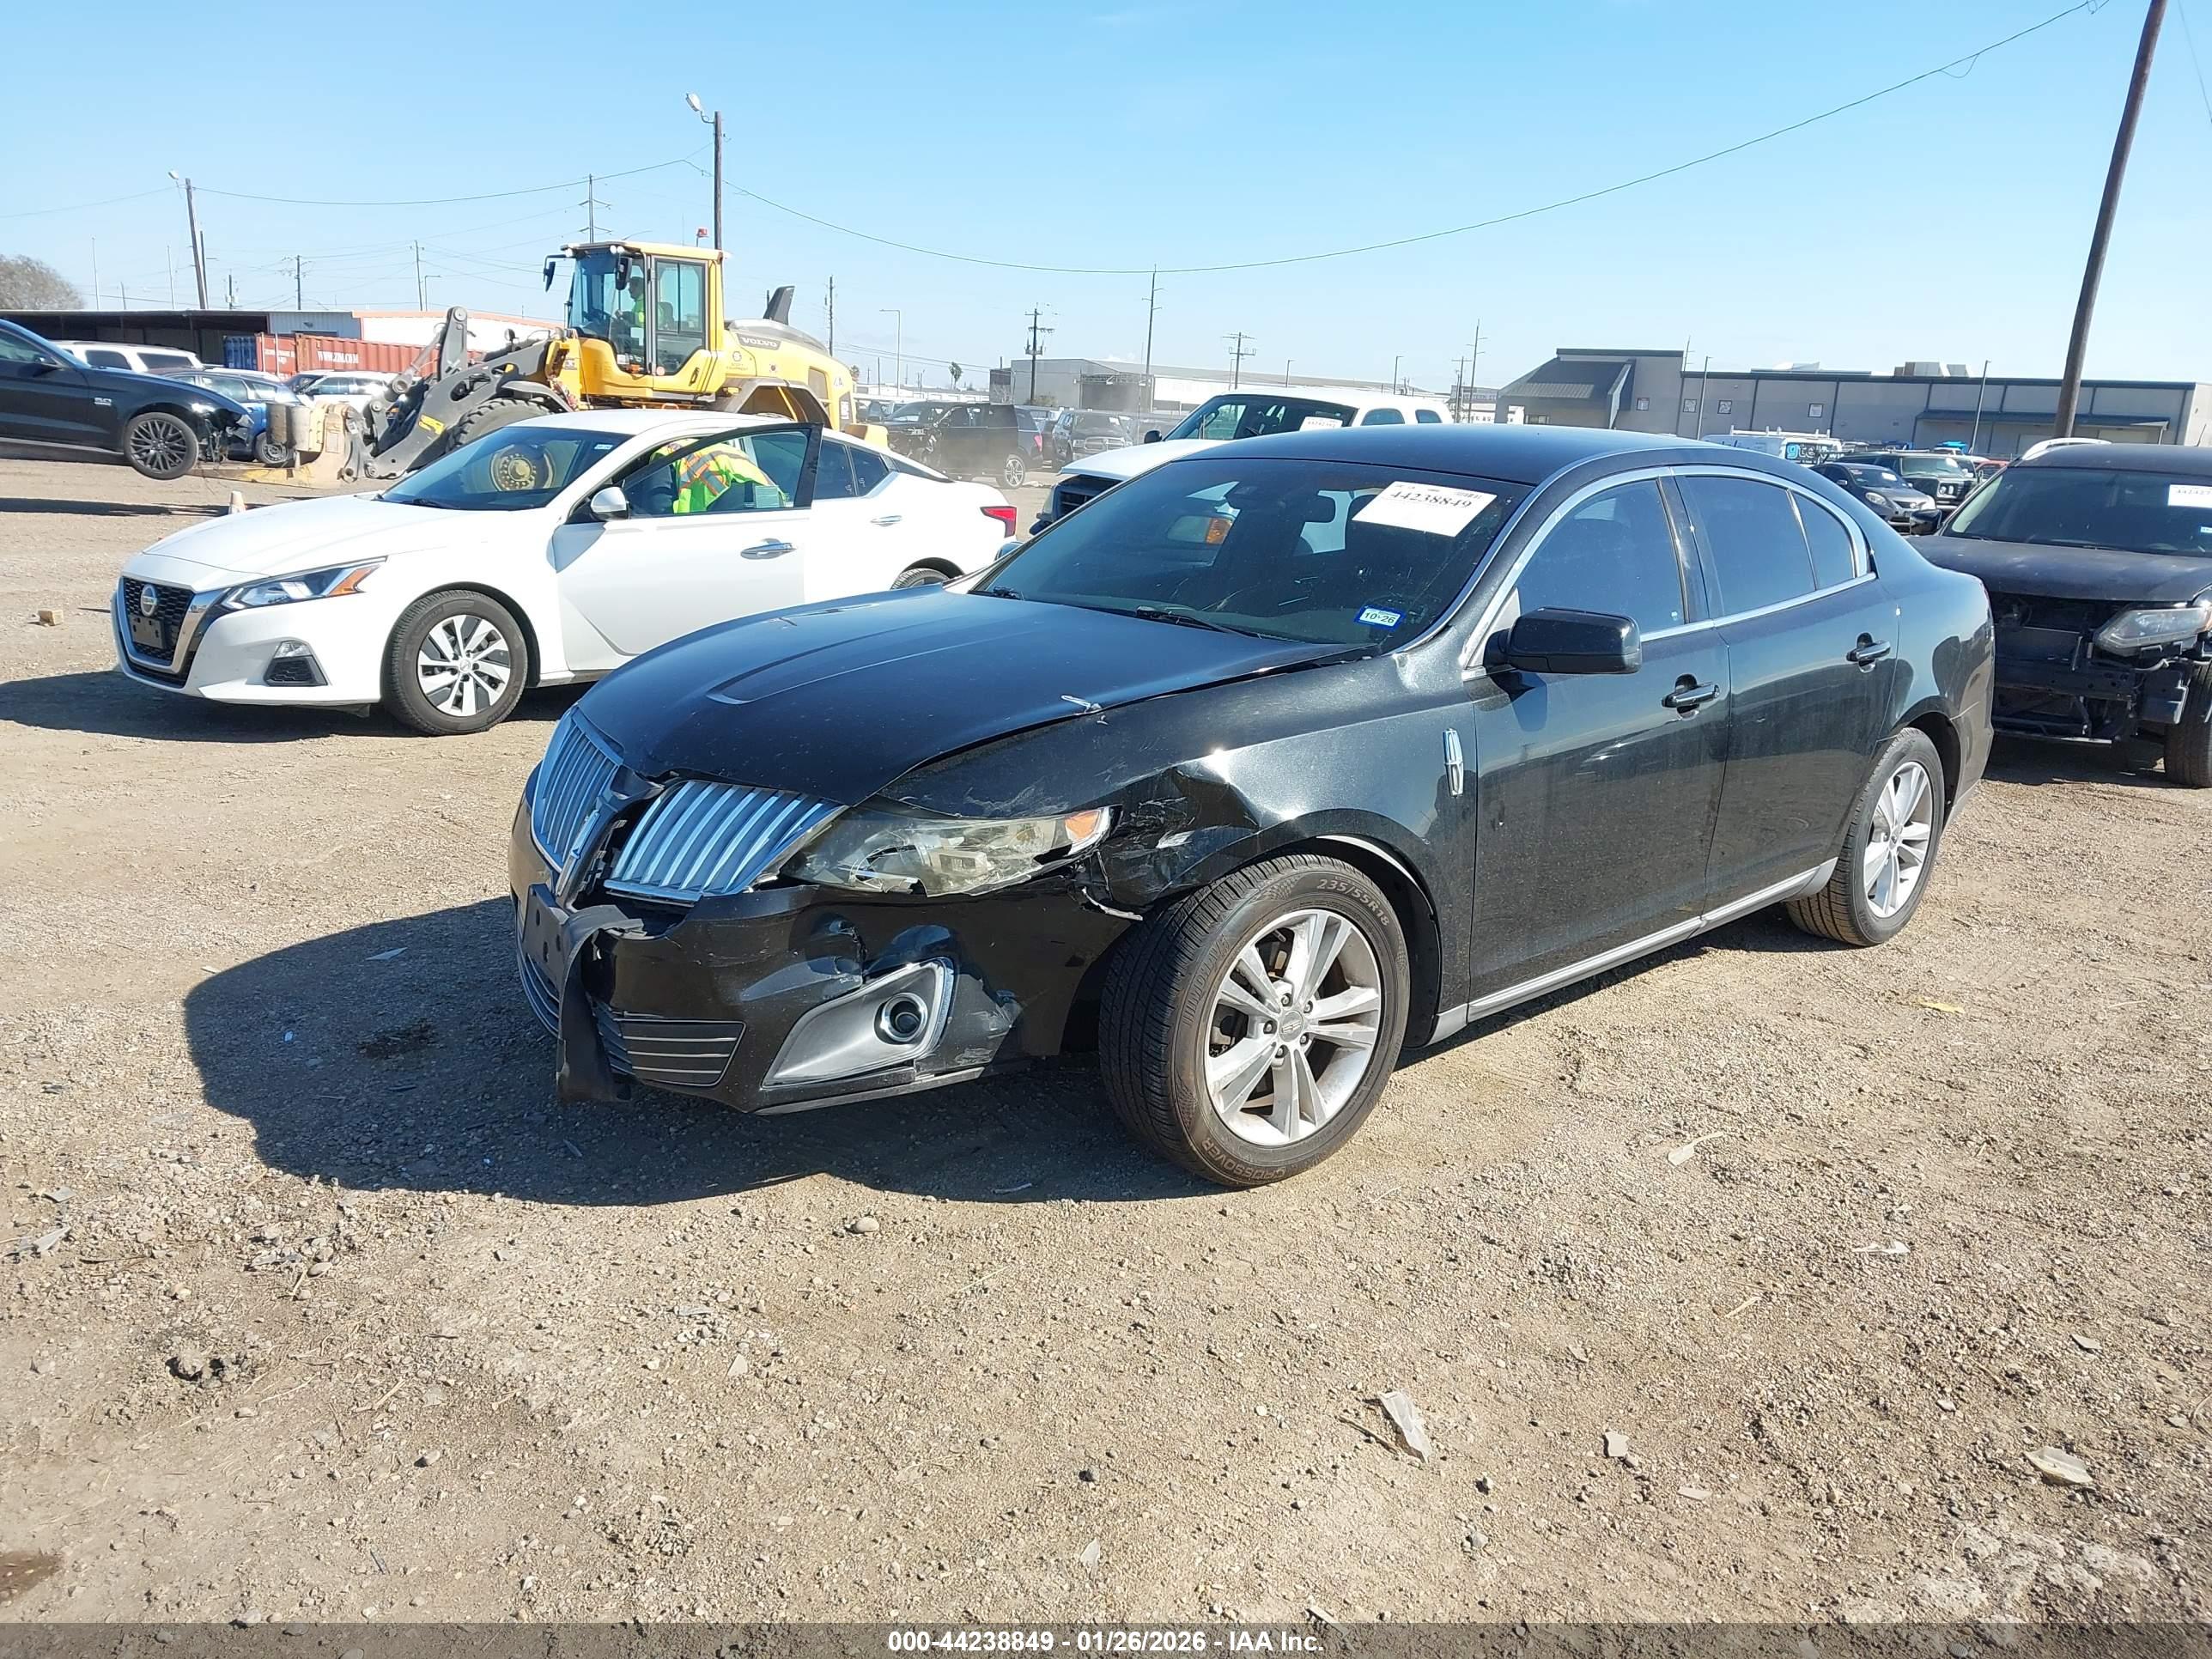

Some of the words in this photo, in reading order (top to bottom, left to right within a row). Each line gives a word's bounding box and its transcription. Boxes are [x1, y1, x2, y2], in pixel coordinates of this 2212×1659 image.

[741, 337, 777, 348] VOLVO
[1389, 490, 1473, 508] 44238849
[1316, 878, 1390, 927] 235/55R18
[1201, 1136, 1287, 1180] CROSSOVER
